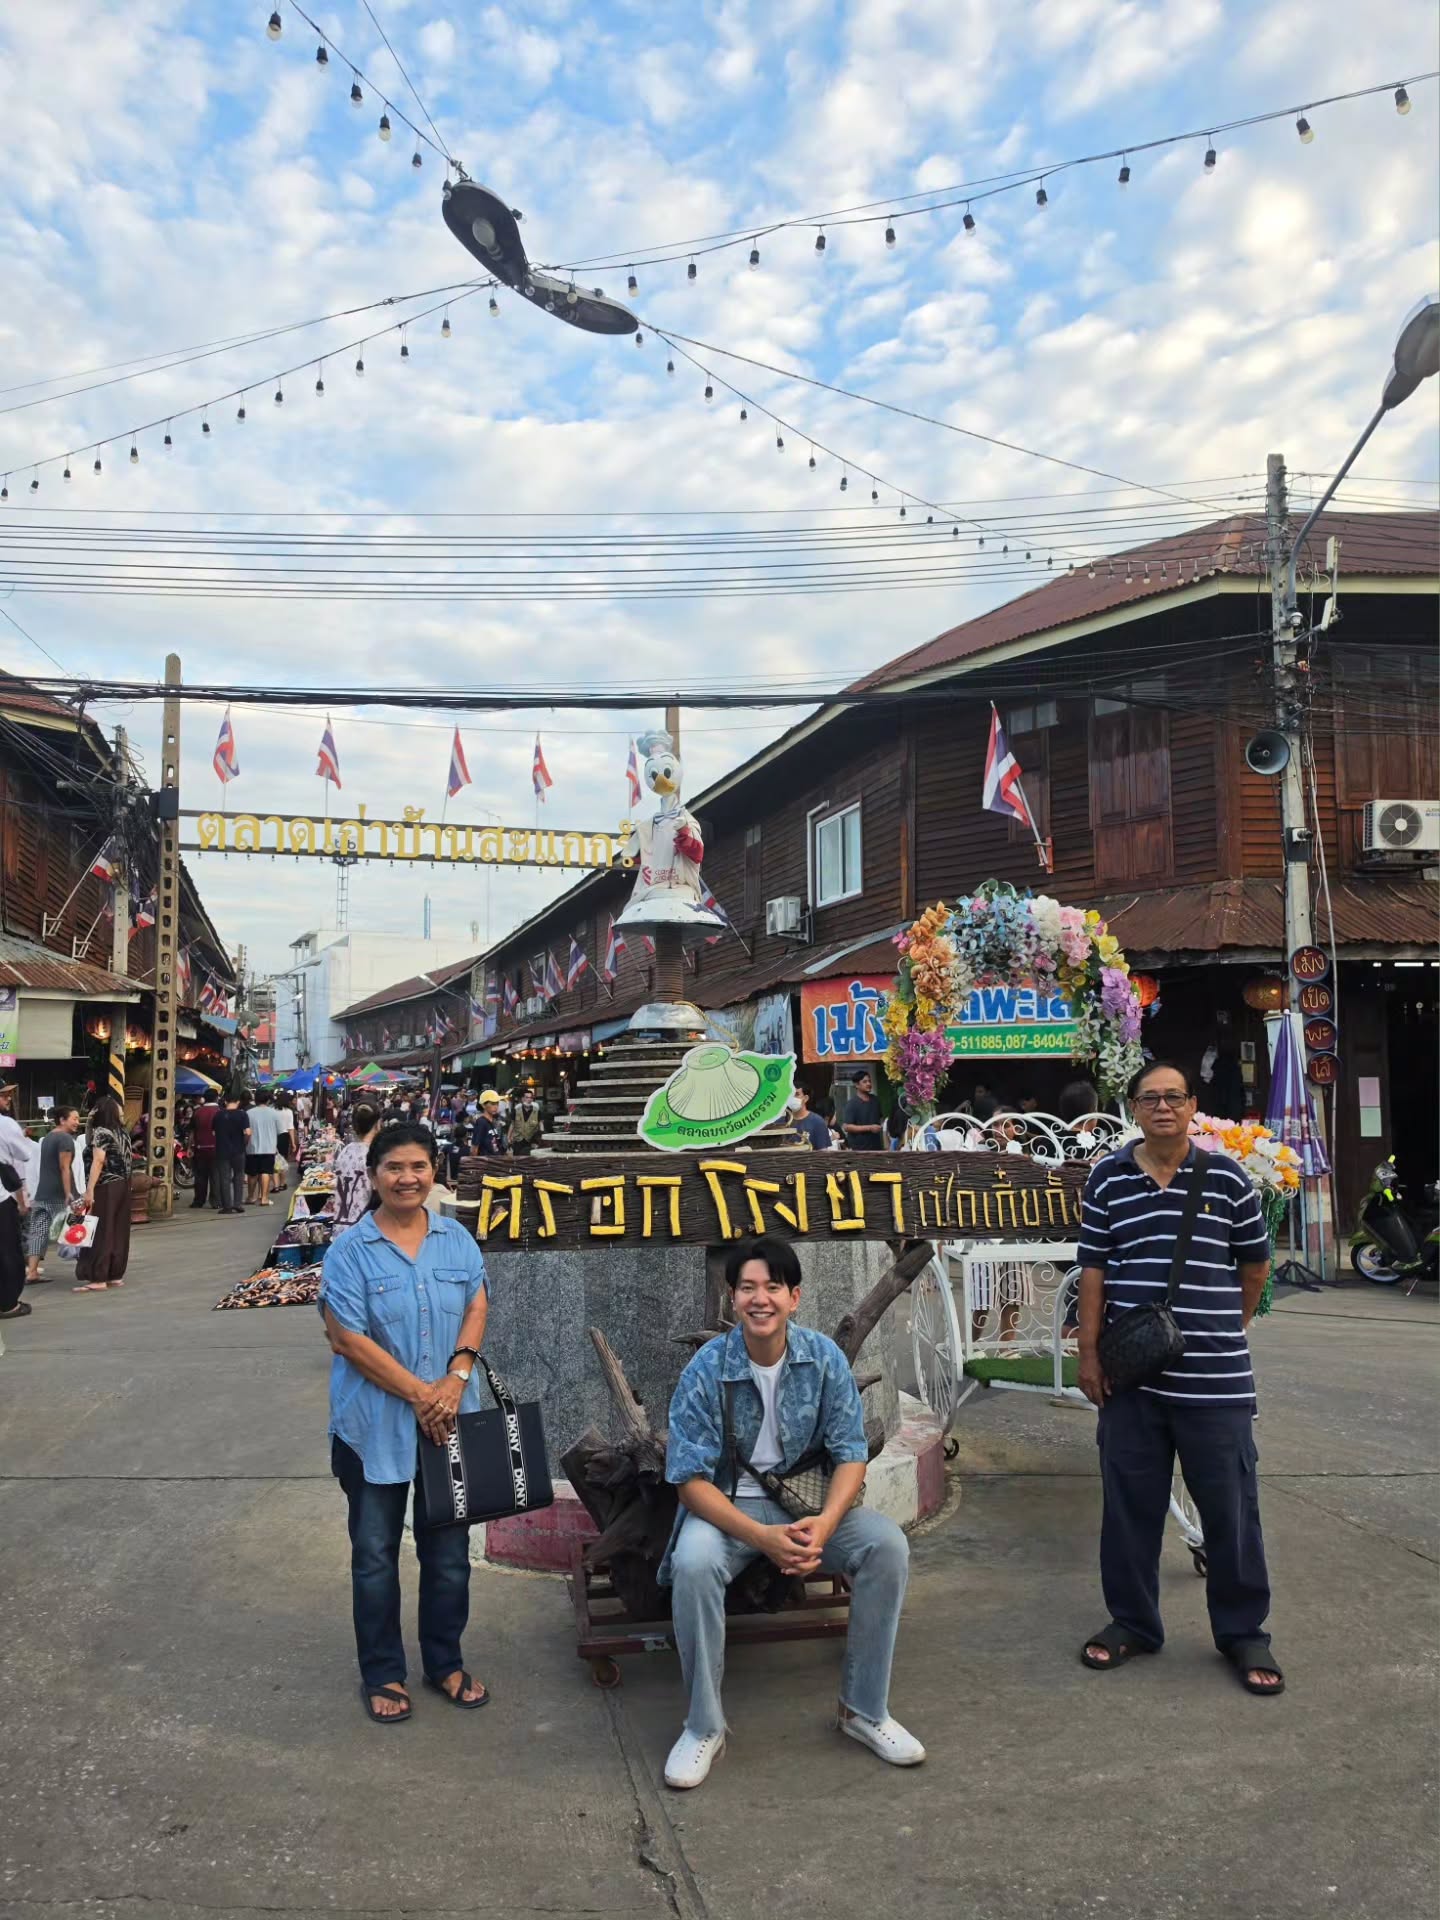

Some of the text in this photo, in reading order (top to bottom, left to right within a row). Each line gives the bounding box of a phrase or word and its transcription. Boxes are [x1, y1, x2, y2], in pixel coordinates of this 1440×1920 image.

[197, 803, 638, 868] ตลาดเก่าบ้านสะแกกรั
[334, 838, 356, 850] tb
[1293, 948, 1325, 974] เม้ง
[1302, 985, 1330, 1008] เป็ด
[1305, 1026, 1331, 1042] พะ
[677, 1091, 777, 1138] ตลาดบกวัฒนธรรม
[476, 1160, 908, 1240] ตรอกโรงยา
[488, 1370, 510, 1400] DKNY
[448, 1431, 460, 1463] DKN
[507, 1414, 521, 1452] DKNY
[454, 1479, 466, 1519] DKNY
[513, 1468, 526, 1507] DKNY
